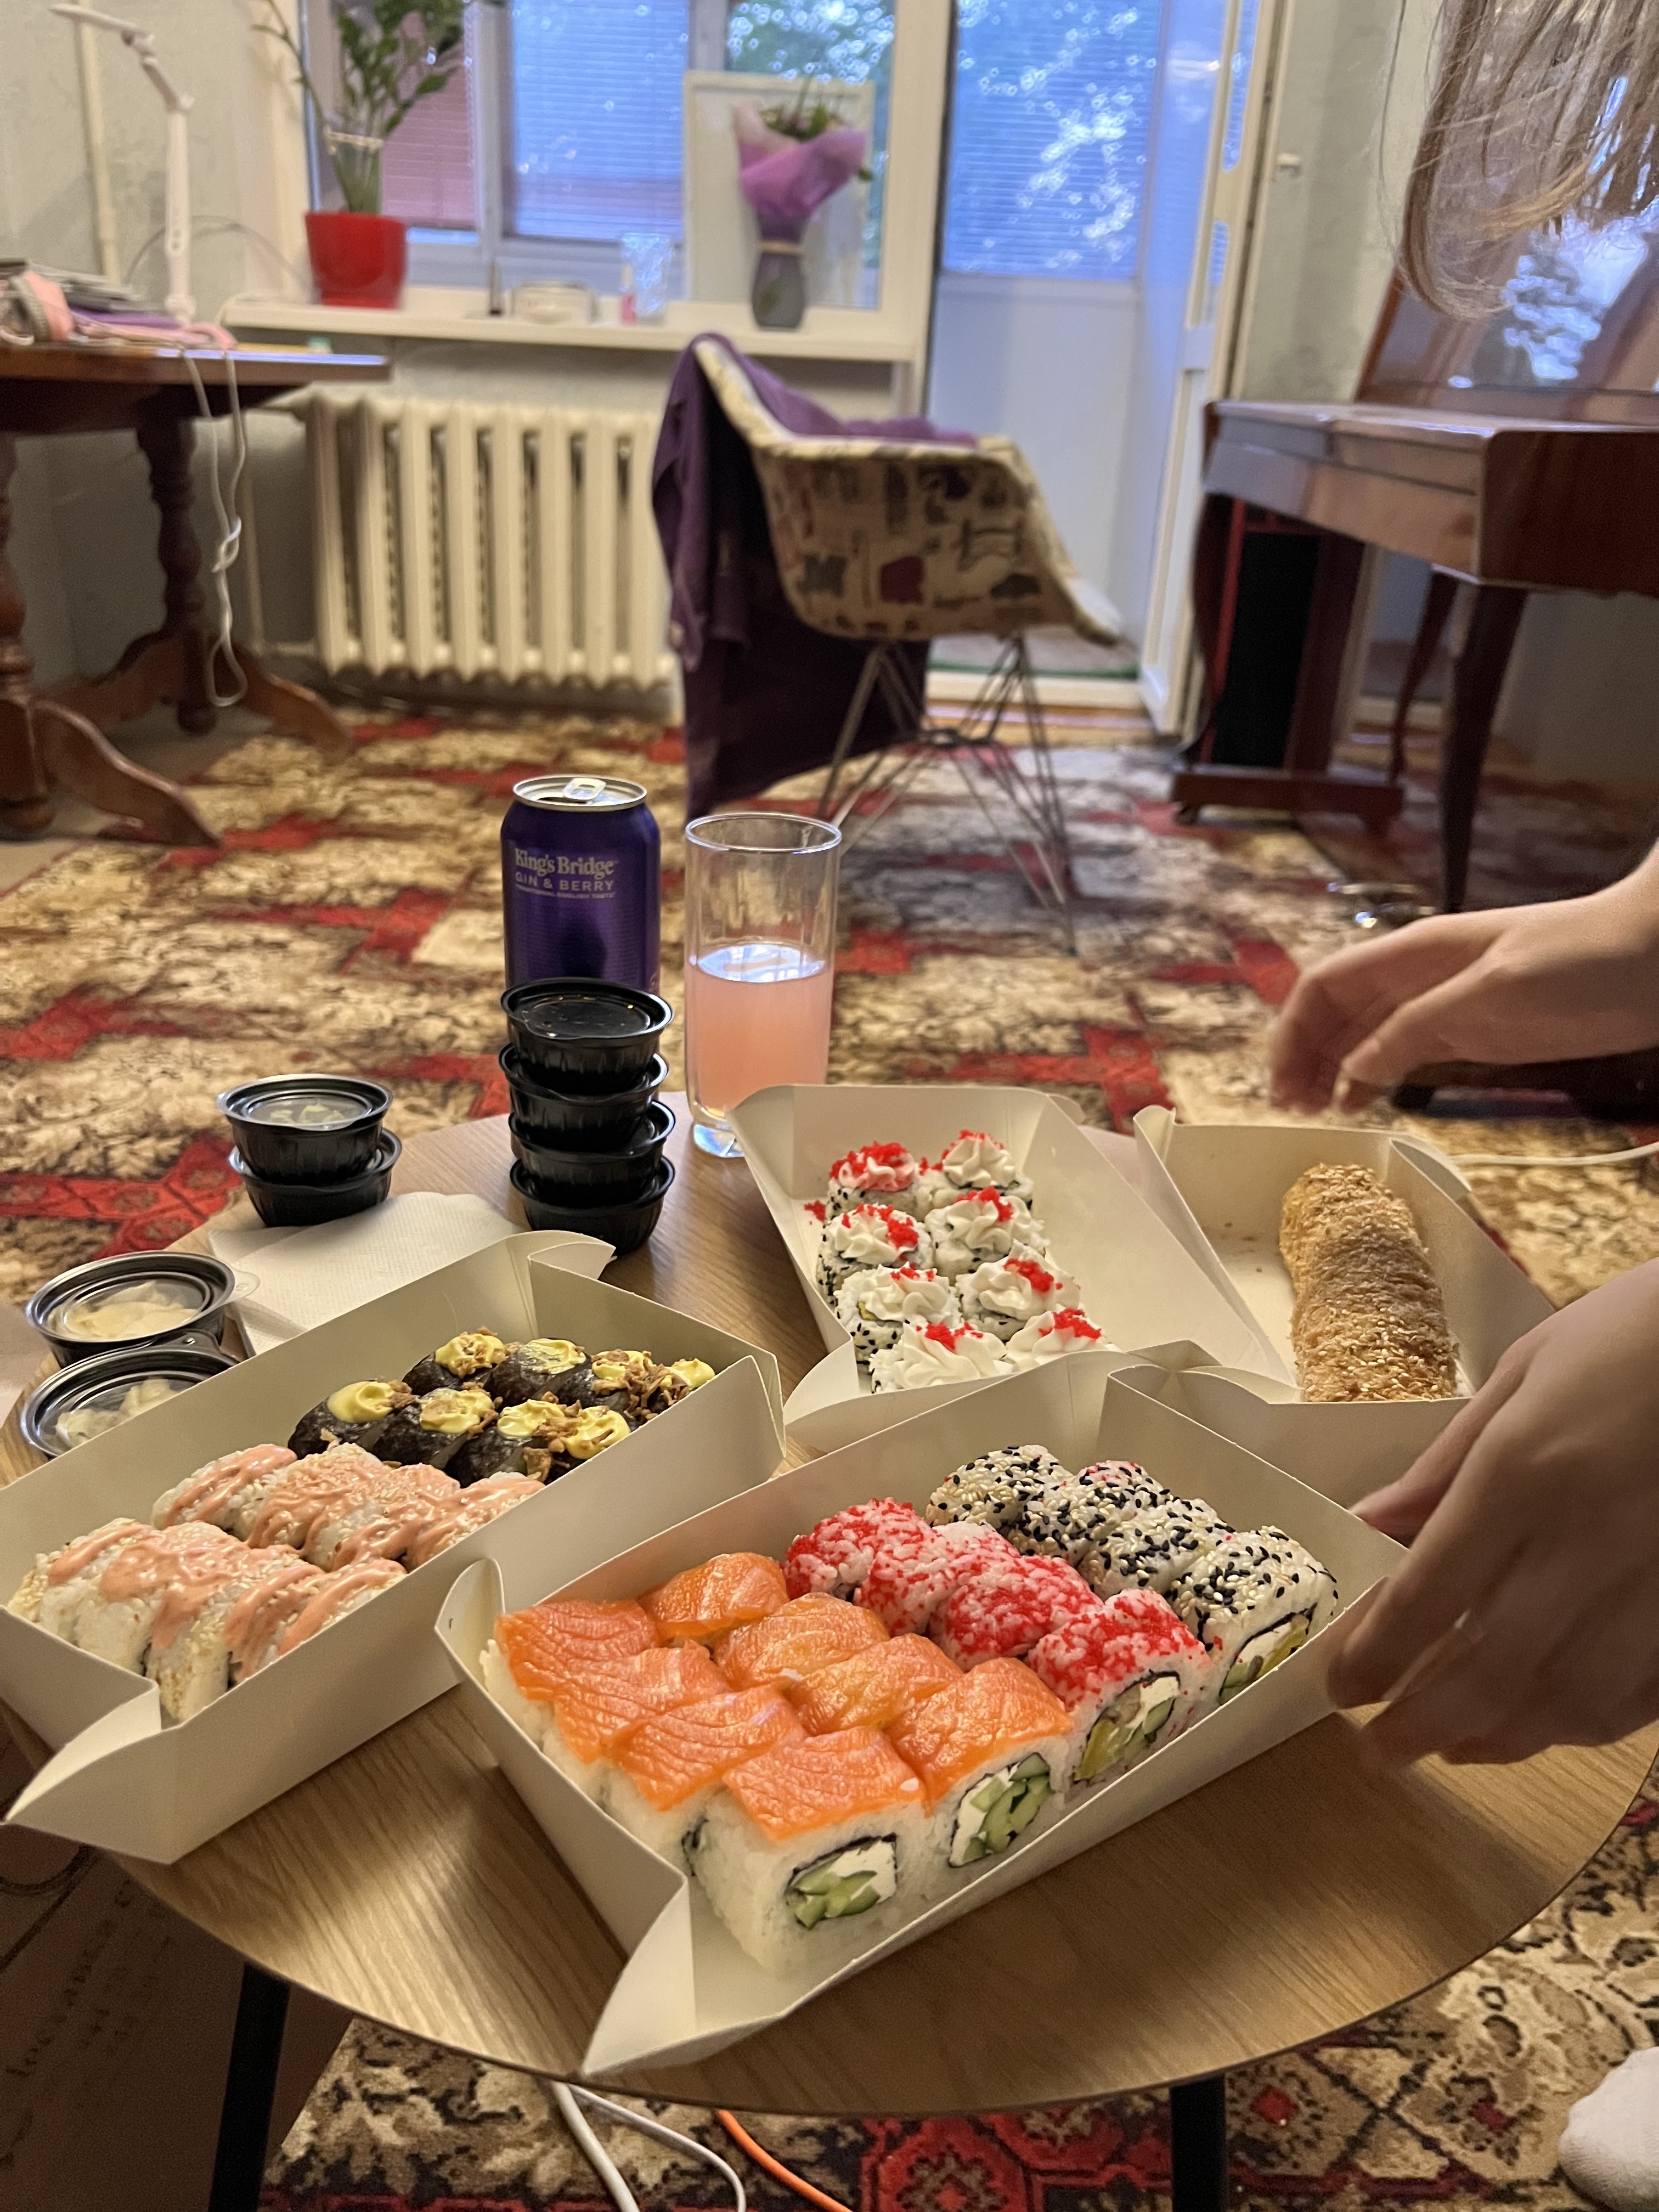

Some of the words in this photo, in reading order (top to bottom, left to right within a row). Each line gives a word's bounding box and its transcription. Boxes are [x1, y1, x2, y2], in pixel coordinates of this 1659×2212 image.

[515, 848, 555, 876] King's
[557, 856, 614, 880] Bridge
[515, 871, 538, 887] GIN
[543, 878, 553, 889] &
[559, 879, 614, 891] BERRY
